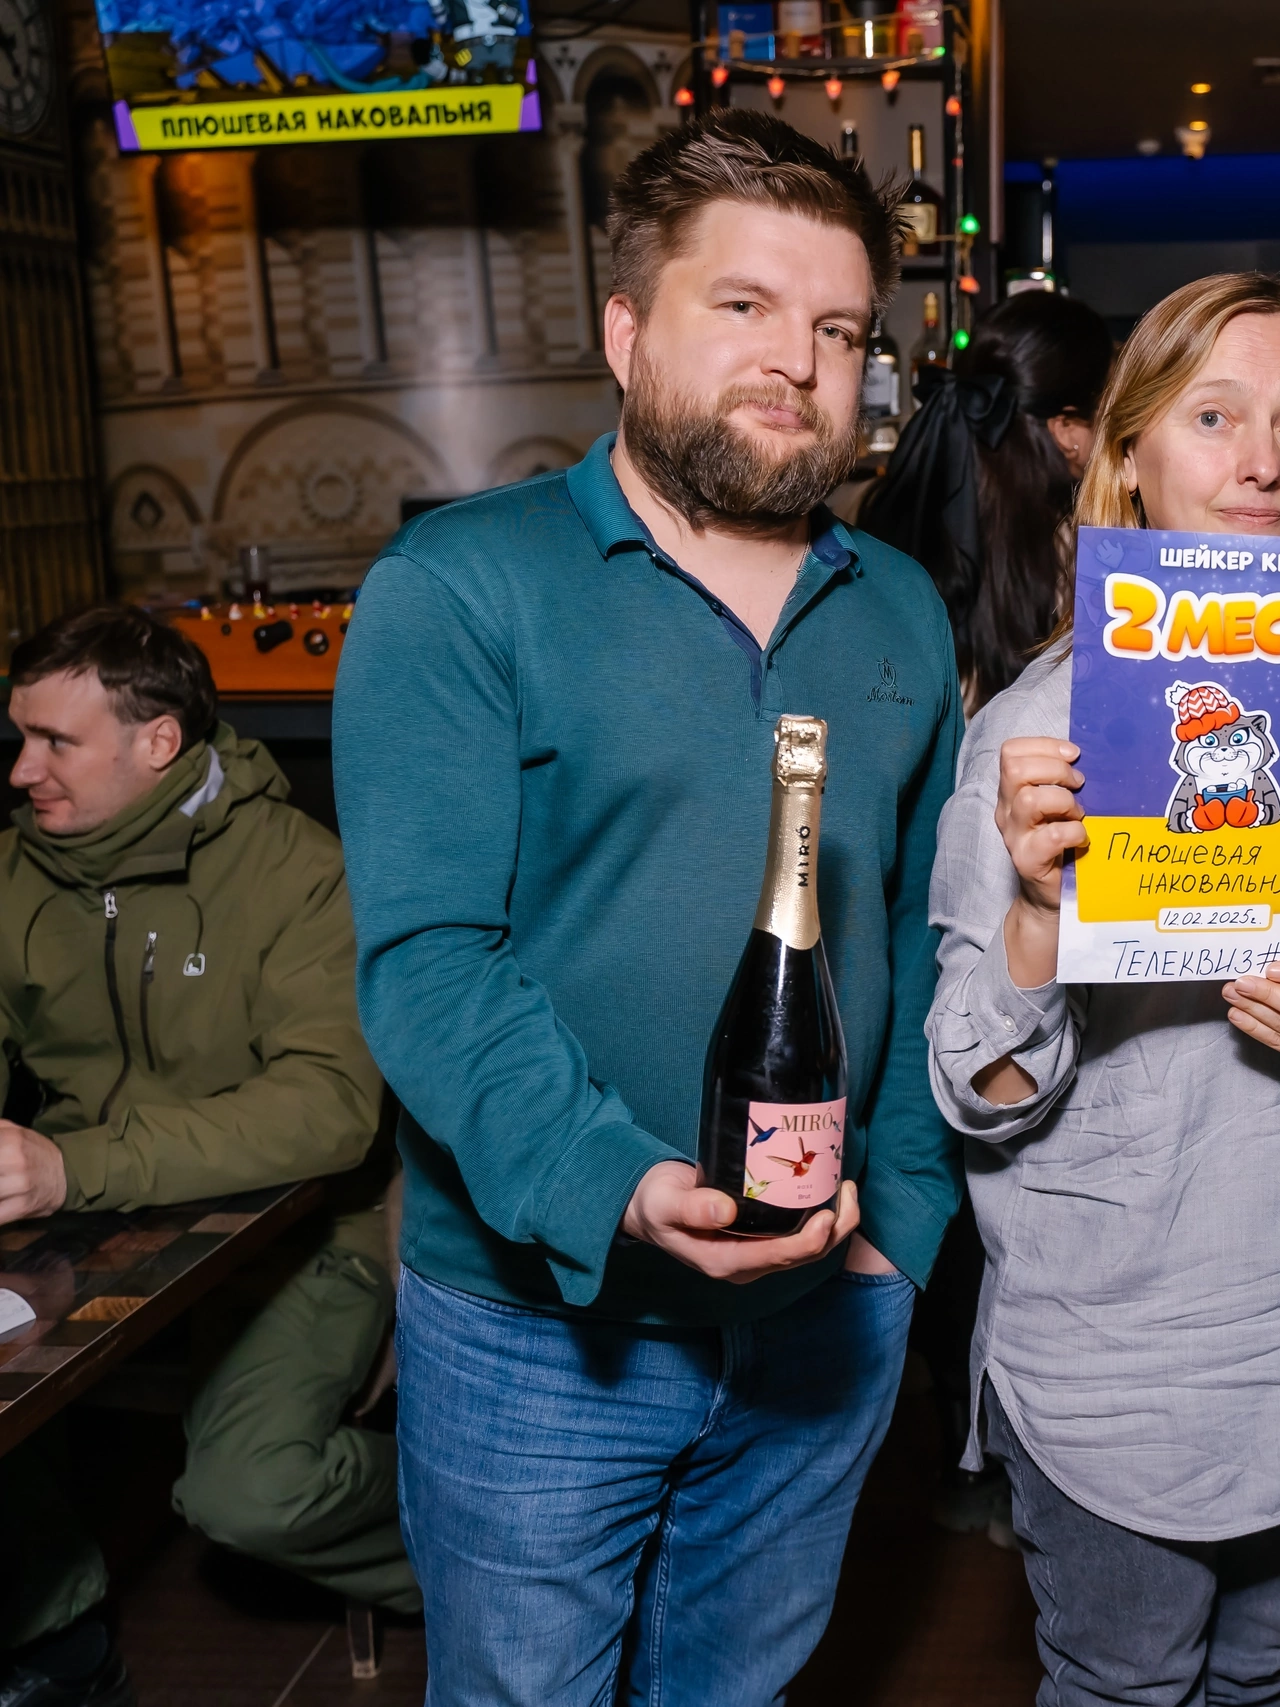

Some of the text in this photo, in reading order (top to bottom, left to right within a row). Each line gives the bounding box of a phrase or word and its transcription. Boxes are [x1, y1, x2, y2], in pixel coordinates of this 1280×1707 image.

[161, 100, 493, 138] ПЛЮШЕВАЯ НАКОВАЛЬНЯ
[1159, 544, 1254, 571] ШЕЙКЕР
[1109, 579, 1160, 655] 2
[779, 1106, 834, 1133] MIRÓ
